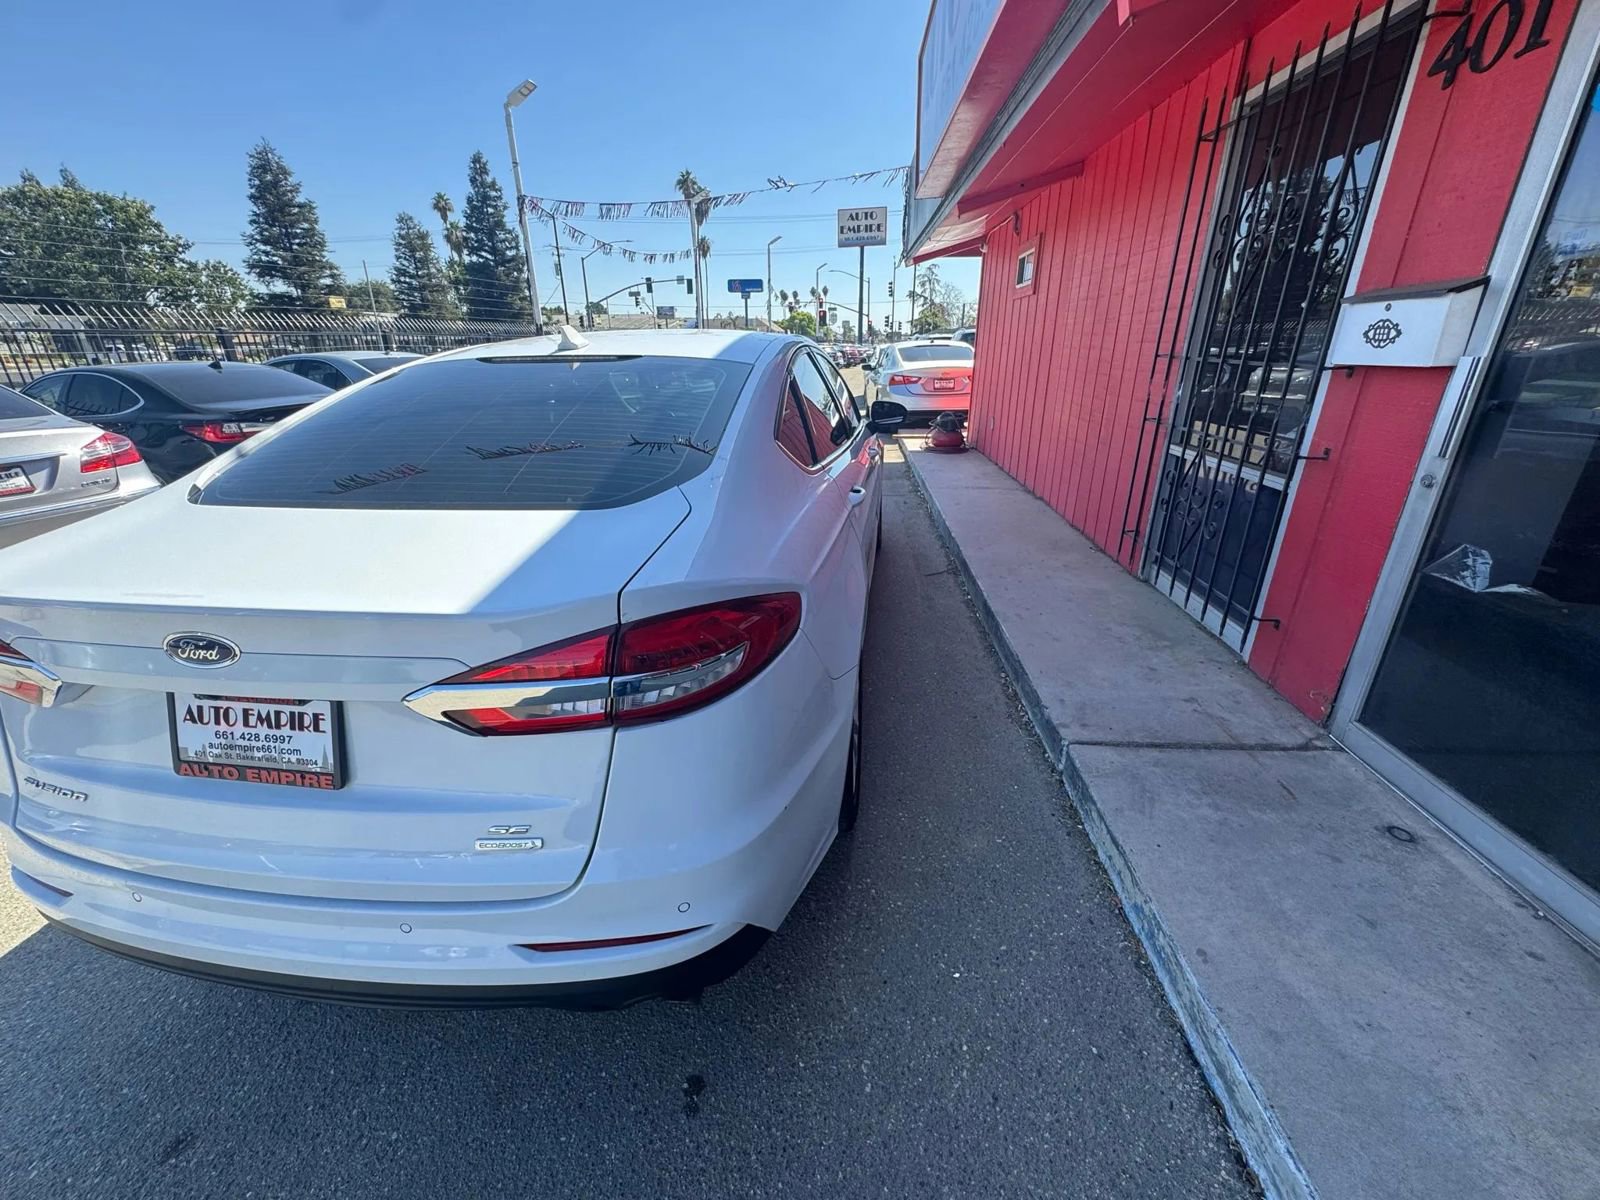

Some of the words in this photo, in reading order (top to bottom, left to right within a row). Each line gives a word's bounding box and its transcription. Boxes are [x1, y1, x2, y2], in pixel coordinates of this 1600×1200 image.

[1427, 0, 1551, 91] 401
[847, 211, 877, 221] AUTO
[840, 223, 883, 234] EMPIRE
[178, 639, 219, 661] Ford
[183, 704, 237, 726] AUTO
[242, 708, 326, 733] EMPIRE
[214, 730, 292, 744] 661.428.6997
[208, 741, 301, 756] autoempire661.com
[179, 762, 239, 780] AUTO
[246, 769, 333, 789] EMPIRE
[488, 825, 532, 834] SE
